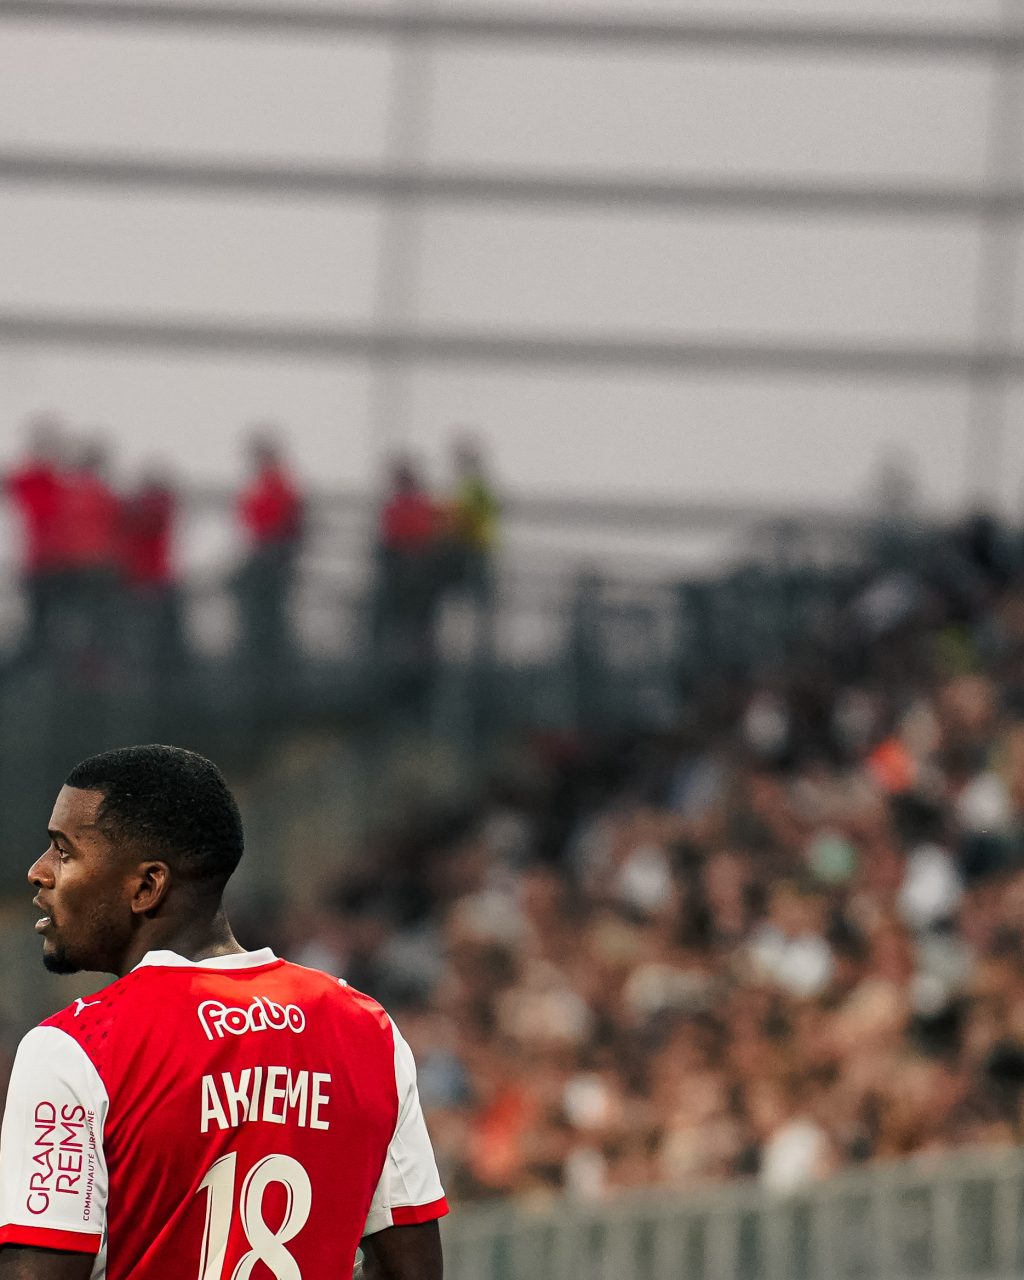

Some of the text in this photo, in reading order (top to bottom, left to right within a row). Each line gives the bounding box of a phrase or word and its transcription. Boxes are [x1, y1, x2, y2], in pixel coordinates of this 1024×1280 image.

[200, 1065, 332, 1133] AKIEME
[26, 1101, 56, 1215] GRAND
[55, 1104, 86, 1195] REIMS
[82, 1153, 95, 1221] COMMUNAUTÉ
